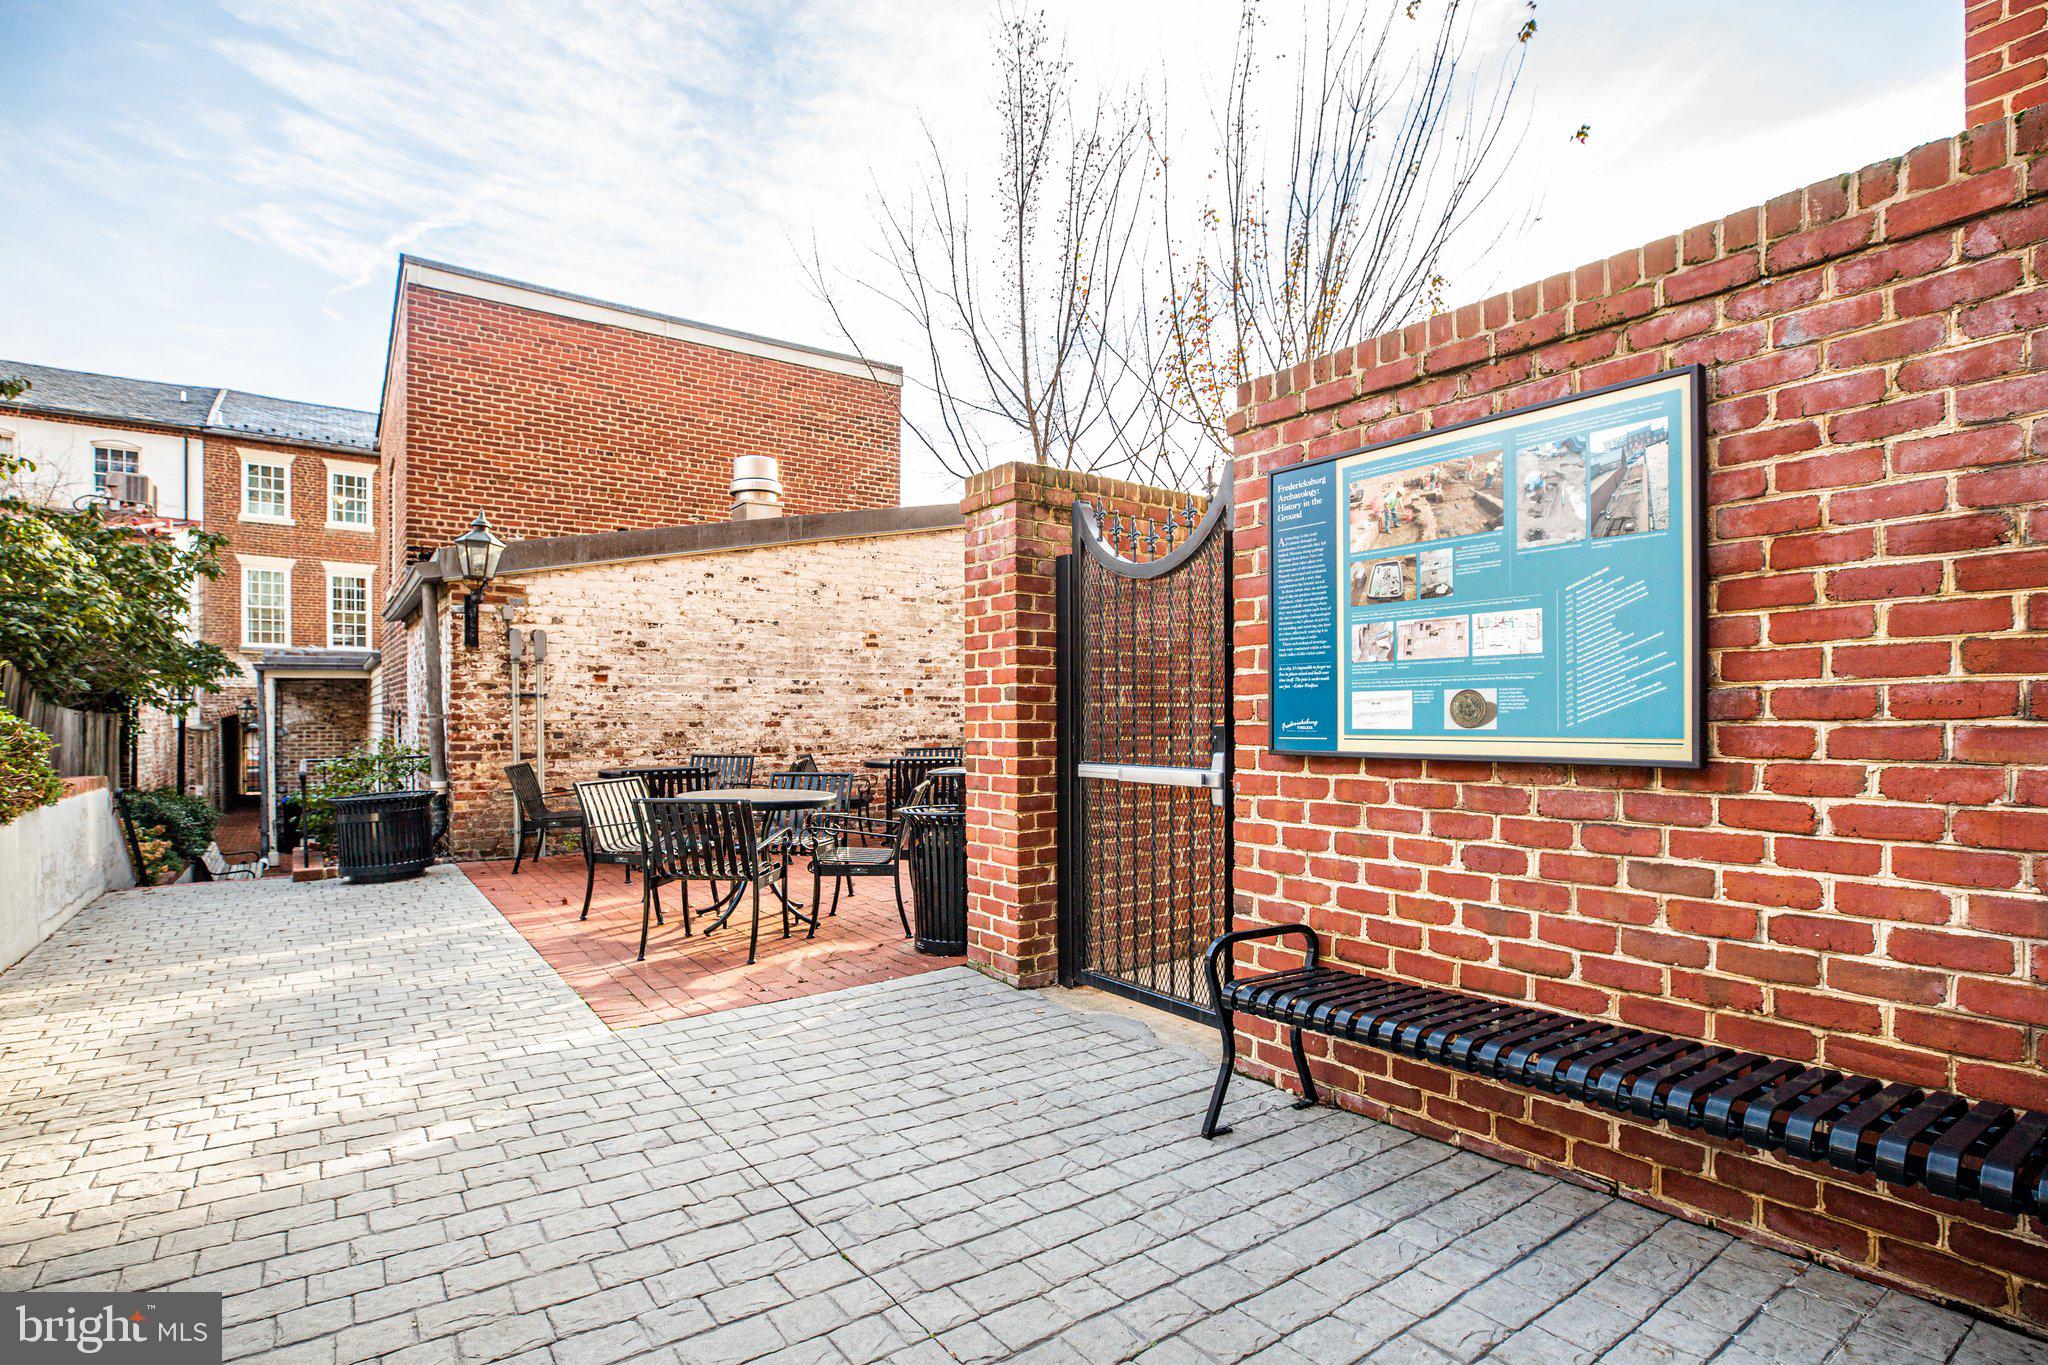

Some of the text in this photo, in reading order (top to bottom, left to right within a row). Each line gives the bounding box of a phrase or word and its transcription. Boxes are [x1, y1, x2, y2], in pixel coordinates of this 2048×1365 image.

[1277, 476, 1327, 493] Fredericksburg
[1277, 488, 1320, 503] Archaeology:
[1277, 497, 1323, 513] History in the
[1277, 510, 1303, 522] Ground
